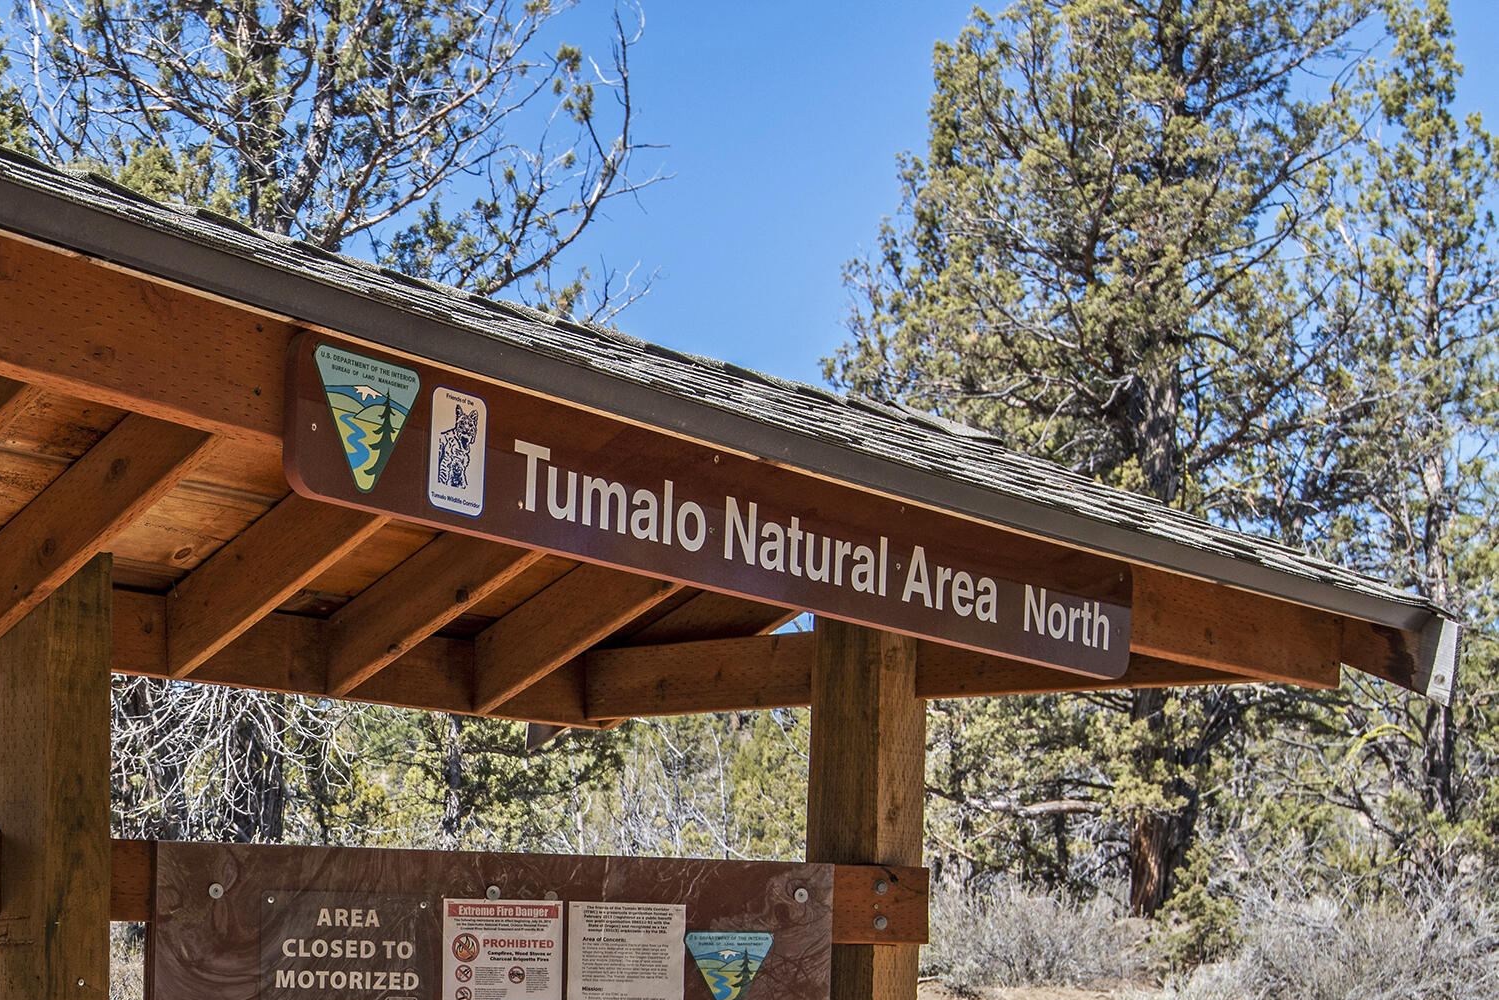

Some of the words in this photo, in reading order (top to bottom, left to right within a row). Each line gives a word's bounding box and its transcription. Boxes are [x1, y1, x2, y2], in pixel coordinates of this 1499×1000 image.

[320, 351, 332, 360] U.S.
[332, 355, 370, 370] DEPARTMENT
[370, 364, 379, 372] OF
[379, 367, 390, 375] THE
[390, 370, 416, 383] INTERIOR
[331, 364, 351, 374] BUREAU
[362, 373, 375, 381] LAND
[377, 377, 409, 391] MANAGEMENT
[445, 392, 462, 402] Friends
[431, 491, 447, 501] Tumalo
[447, 495, 462, 505] Wildlife
[462, 499, 481, 509] Corridor
[513, 438, 707, 553] Tumalo
[724, 495, 888, 597] Natural
[902, 544, 998, 624] Area
[1024, 583, 1111, 651] North
[316, 908, 380, 928] AREA
[458, 905, 495, 916] Extreme
[496, 906, 514, 916] Fire
[515, 906, 549, 918] Danger
[282, 938, 376, 959] CLOSED
[382, 941, 414, 960] TO
[483, 938, 554, 949] PROHIBITED
[275, 969, 419, 991] MOTORIZED
